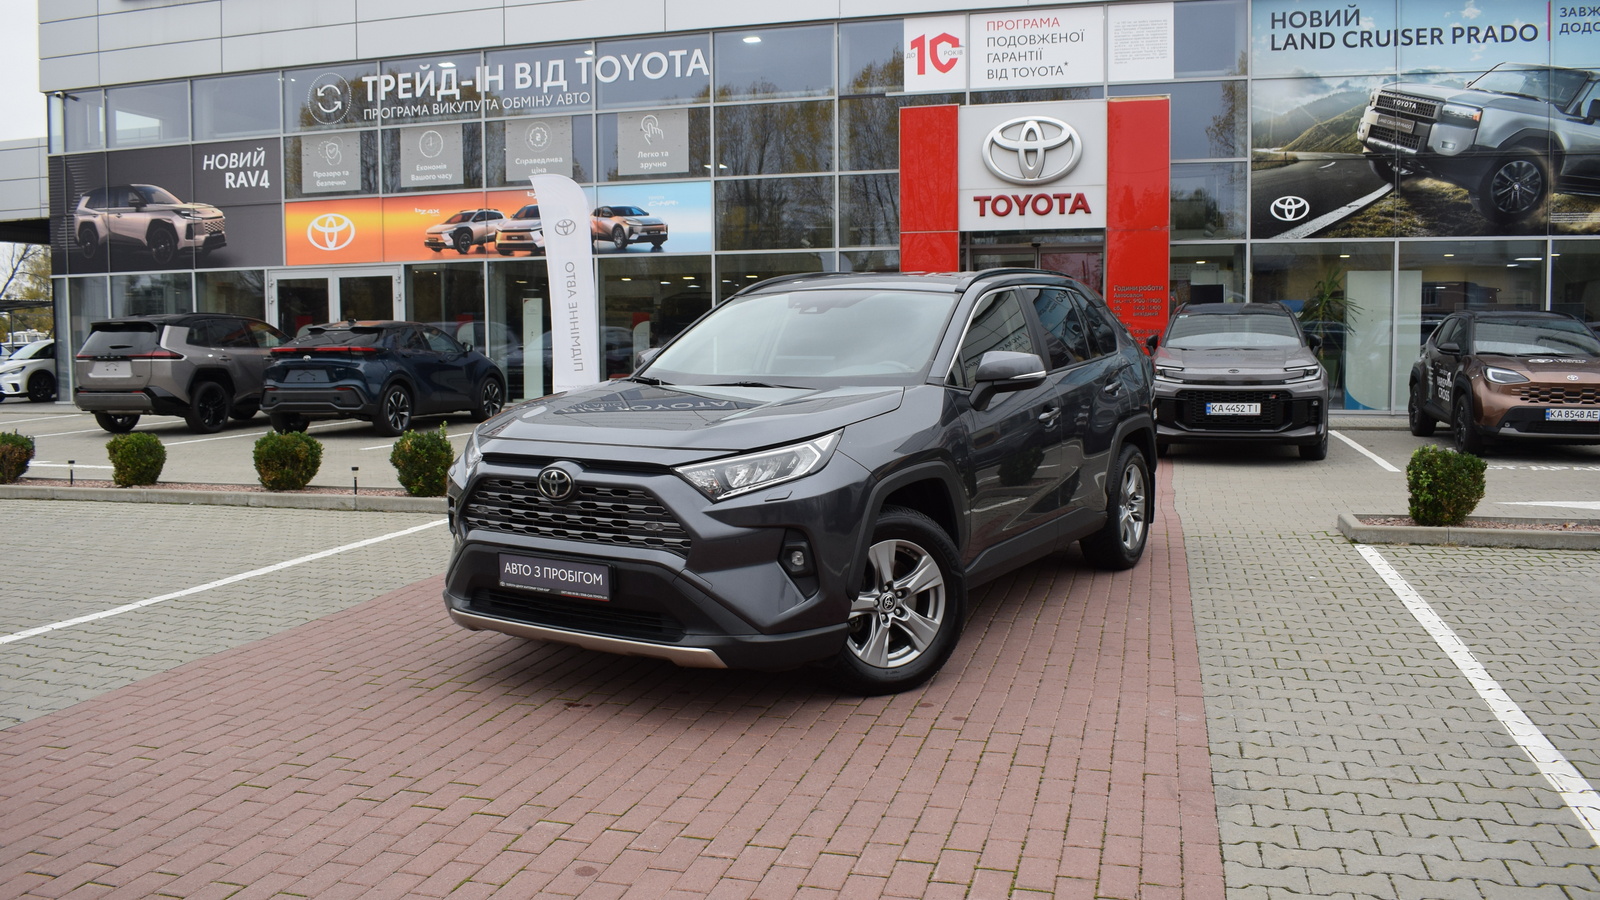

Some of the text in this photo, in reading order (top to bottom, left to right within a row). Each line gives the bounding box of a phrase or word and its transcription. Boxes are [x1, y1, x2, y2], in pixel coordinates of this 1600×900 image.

[1271, 4, 1360, 29] НОВИЙ
[986, 17, 1060, 31] ПРОГРАМА
[987, 29, 1086, 48] ПОДОВЖЕНОЇ
[1271, 24, 1539, 51] LAND CRUISER PRADO
[987, 47, 1044, 63] ГАРАНТІЇ
[362, 48, 710, 102] ТРЕЙД-ІН ВІД TOYOTA
[987, 68, 1009, 81] ВІД
[363, 92, 590, 120] ПРОГРАМА ВИКУПУ ТА ОБМІНУ АВТО
[1392, 99, 1417, 109] TOYOTA
[203, 147, 265, 170] НОВИЙ
[515, 157, 563, 165] Справедлива
[637, 151, 659, 159] Легко
[416, 163, 447, 171] Економія
[639, 161, 667, 169] зручно
[225, 170, 270, 189] RAV4
[316, 179, 347, 187] безпечно
[411, 173, 453, 182] Вашого часу
[973, 193, 1092, 217] TOYOTA
[1138, 284, 1163, 292] роботи
[1211, 404, 1224, 413] KA
[1225, 404, 1246, 413] 4452
[1550, 410, 1599, 419] KA 8548 AE
[504, 562, 603, 586] АВТО З ПРОБІГОМ
